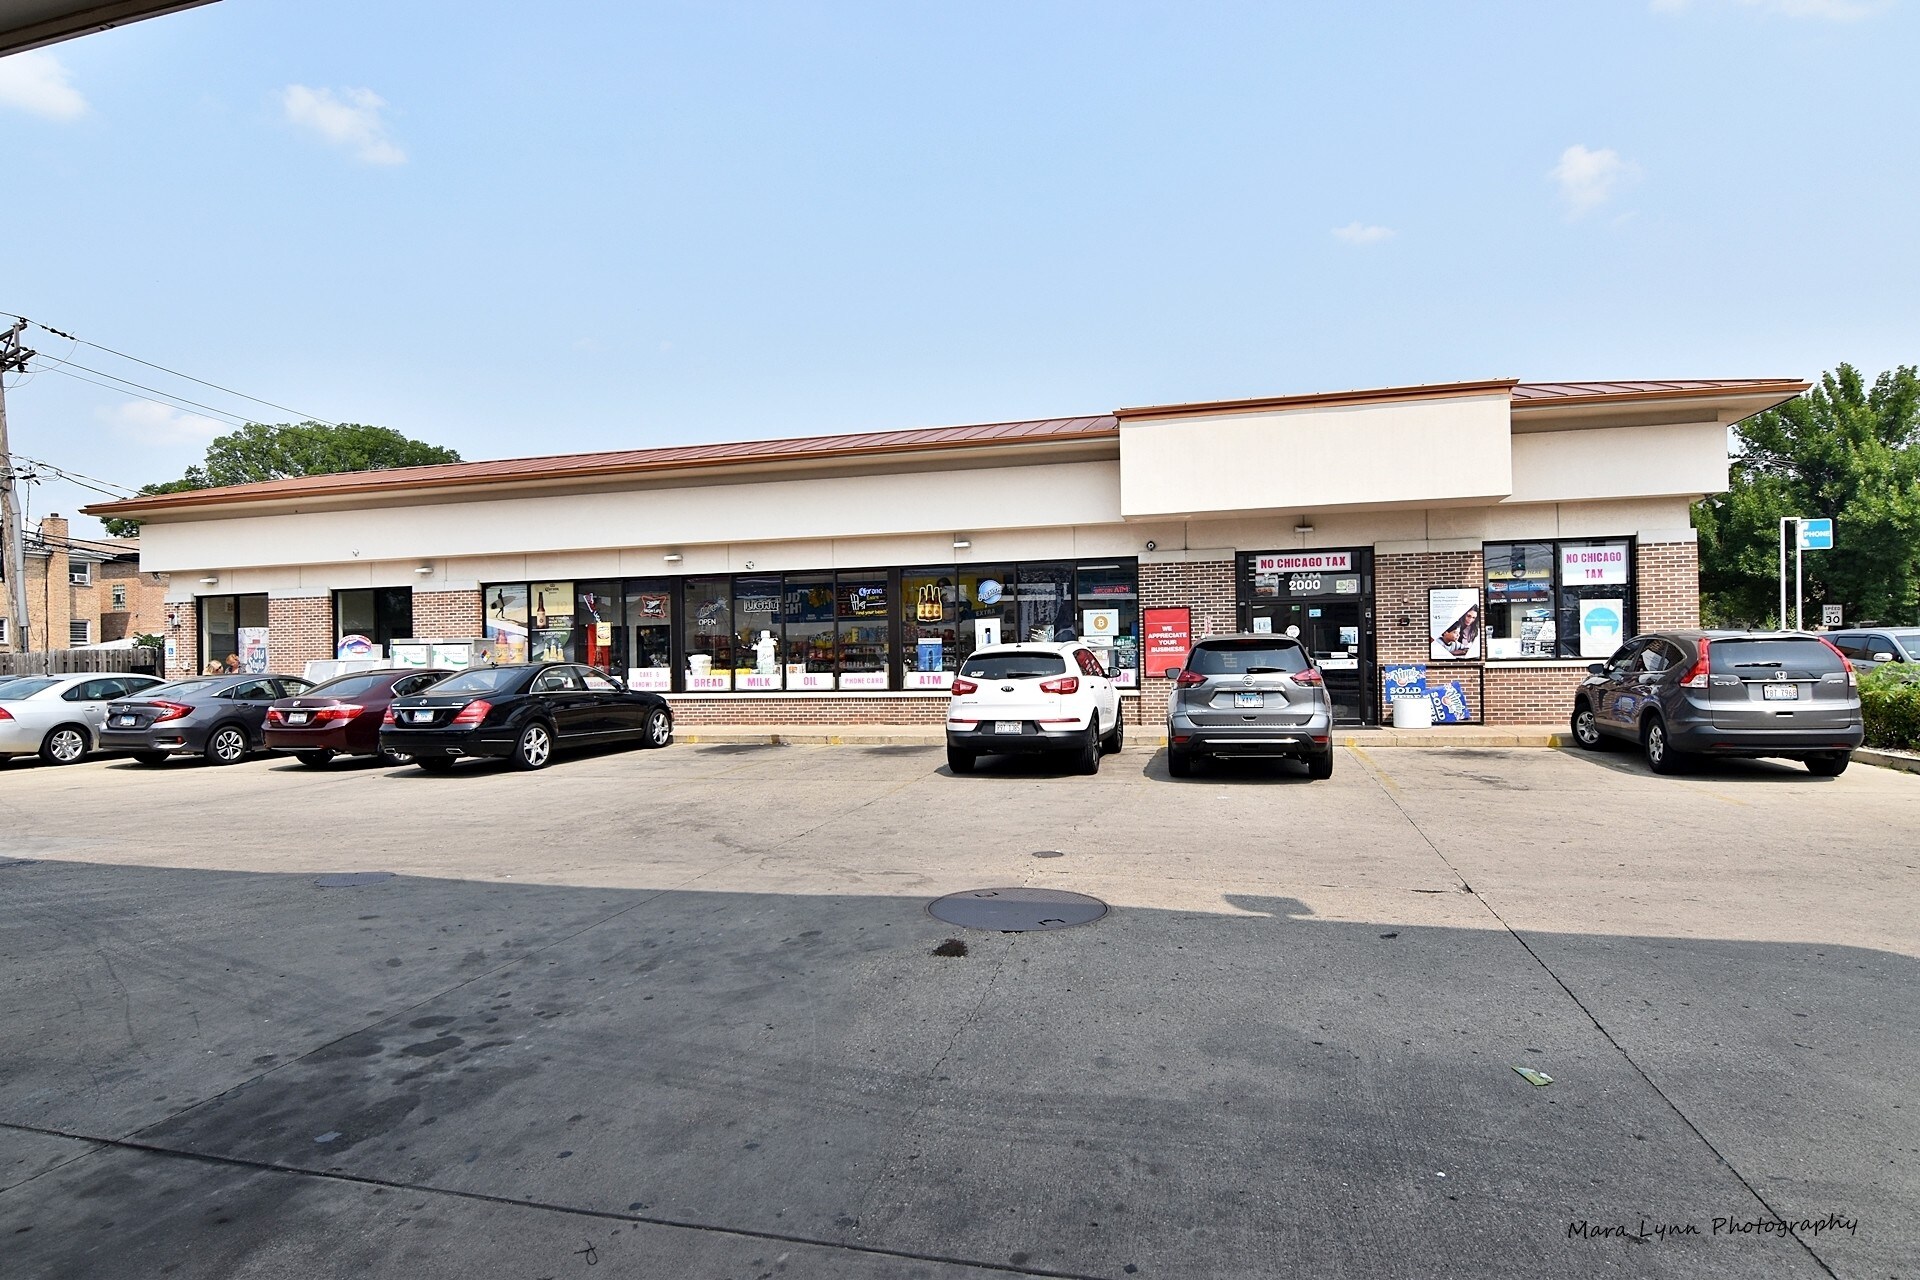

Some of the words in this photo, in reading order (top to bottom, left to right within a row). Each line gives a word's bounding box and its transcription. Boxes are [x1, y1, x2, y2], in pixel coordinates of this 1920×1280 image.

[1804, 530, 1831, 538] PHONE
[1260, 559, 1274, 569] NO
[1277, 557, 1322, 568] CHICAGO
[1325, 556, 1346, 566] TAX
[1566, 553, 1578, 564] NO
[1581, 551, 1622, 563] CHICAGO
[1291, 572, 1322, 580] ATM
[1585, 568, 1603, 579] TAX
[1289, 580, 1321, 591] 2000
[858, 587, 883, 597] Corona
[975, 608, 996, 617] EXTRA
[698, 618, 717, 626] OPEN
[1825, 615, 1840, 624] 30
[694, 678, 724, 687] BREAD
[747, 677, 771, 687] MILK
[803, 676, 818, 686] OIL
[919, 675, 942, 685] ATM
[1431, 691, 1446, 721] SOLD
